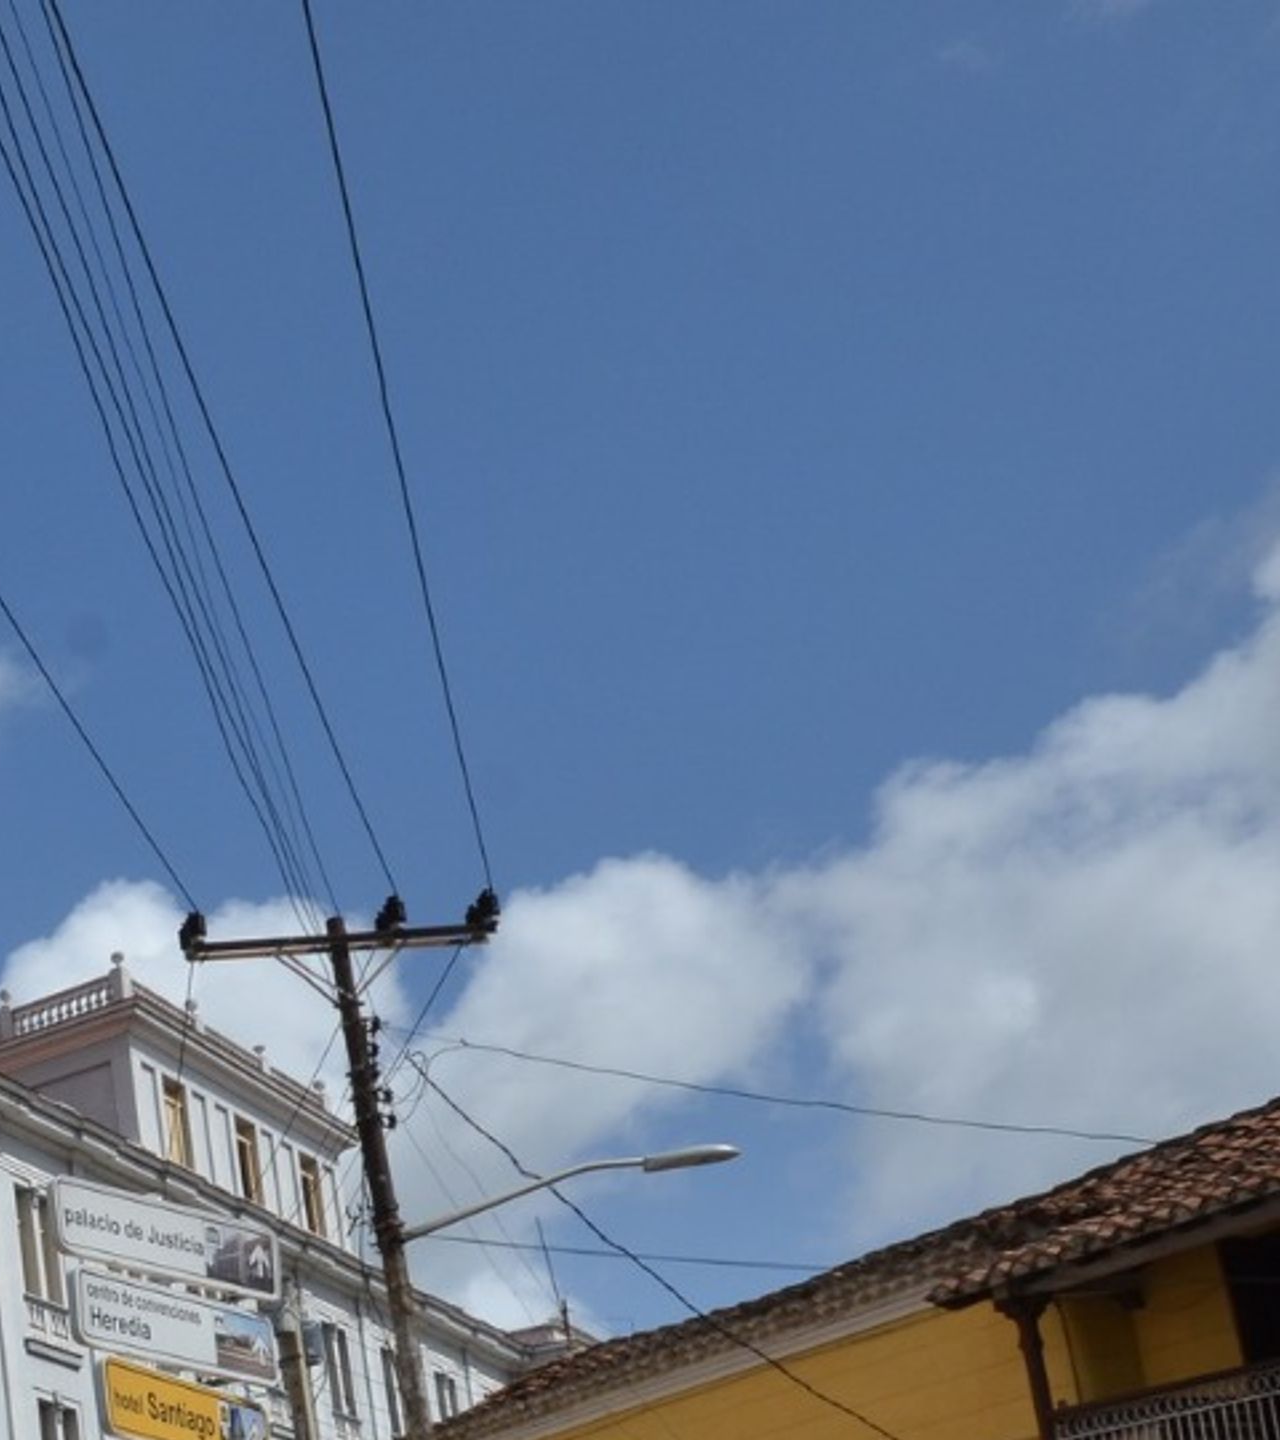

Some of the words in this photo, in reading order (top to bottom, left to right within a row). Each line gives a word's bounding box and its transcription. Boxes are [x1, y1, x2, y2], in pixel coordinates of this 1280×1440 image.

[64, 1207, 121, 1236] palacio
[124, 1219, 143, 1241] de
[148, 1224, 205, 1256] Justicia
[121, 1290, 133, 1308] de
[90, 1305, 151, 1340] Heredia
[114, 1388, 143, 1415] hotel
[147, 1392, 215, 1440] Santiago
